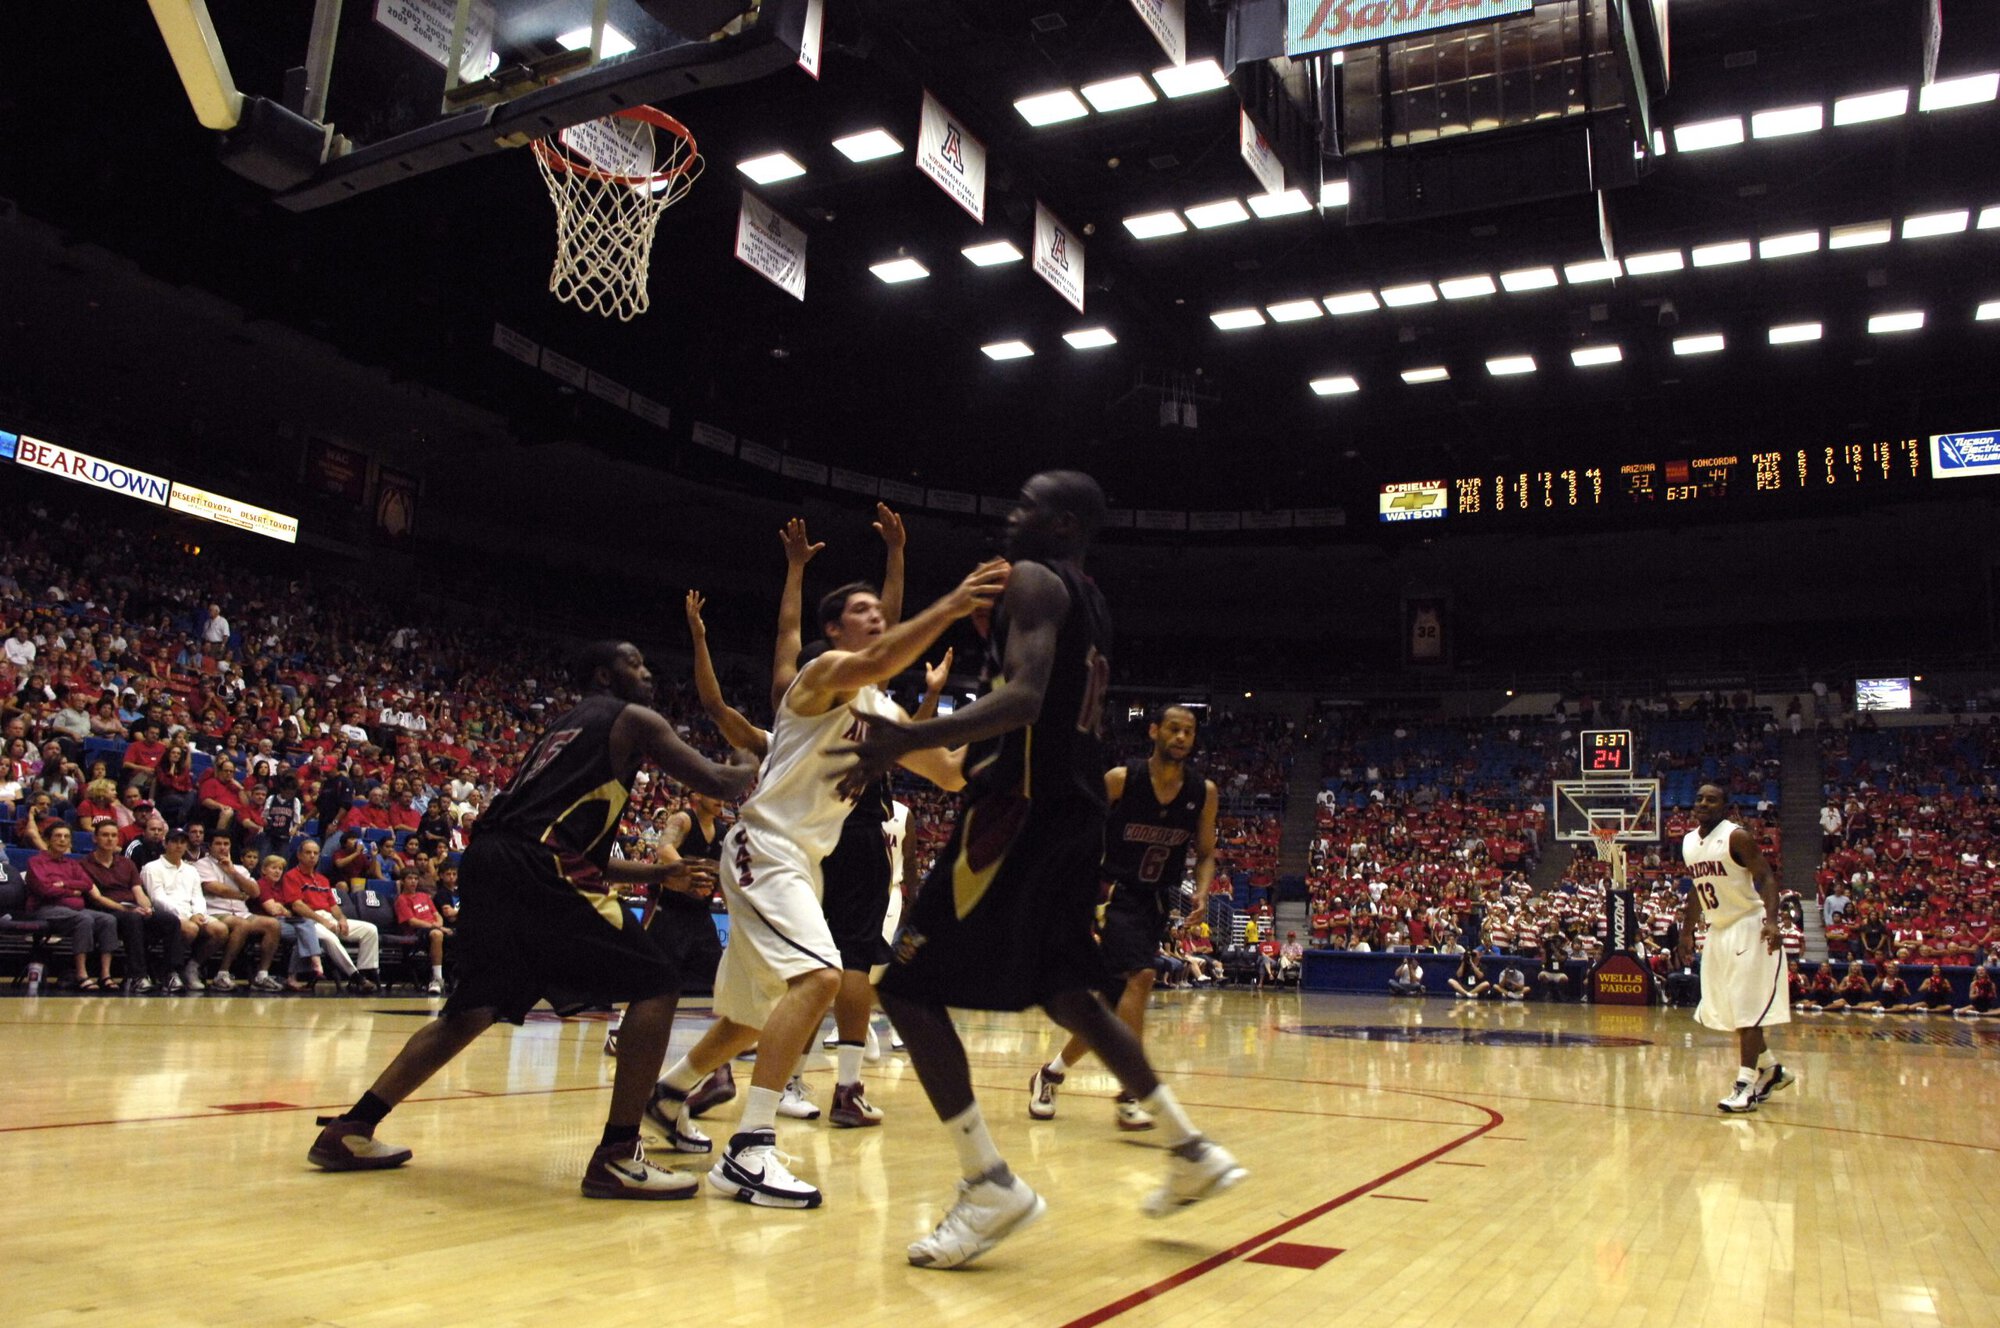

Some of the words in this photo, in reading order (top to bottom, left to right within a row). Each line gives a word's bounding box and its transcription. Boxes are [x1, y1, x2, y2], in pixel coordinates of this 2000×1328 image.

[942, 120, 964, 175] A
[1051, 226, 1068, 272] A
[1955, 437, 1994, 448] Tucson
[1752, 452, 1781, 464] PLYR
[1901, 439, 1917, 450] 15
[1621, 463, 1656, 474] ARIZONA
[1692, 456, 1738, 468] CONCORDIA
[1757, 461, 1778, 471] PTS
[1456, 478, 1481, 489] PLYR
[1585, 468, 1602, 478] 44
[1632, 474, 1649, 488] 53
[1708, 467, 1728, 482] 44
[1757, 470, 1780, 481] RBS
[1385, 480, 1441, 494] O'RIELLY
[1757, 479, 1780, 490] FLS
[1461, 487, 1478, 497] PTS
[1667, 485, 1698, 501] 6:37
[172, 490, 201, 505] DESERT
[203, 499, 232, 513] TOYOTA
[240, 511, 267, 525] DESERT
[270, 519, 296, 533] TOYOTA
[1386, 510, 1443, 522] WATSON
[1417, 625, 1436, 639] 32
[1595, 734, 1626, 746] 6:37
[1593, 749, 1621, 769] 24
[735, 828, 755, 888] CATS
[1138, 845, 1170, 882] 6
[1697, 882, 1720, 910] 13
[1613, 893, 1625, 951] ARIZONA
[1598, 973, 1643, 984] WELLS
[1599, 984, 1643, 994] FARGO
